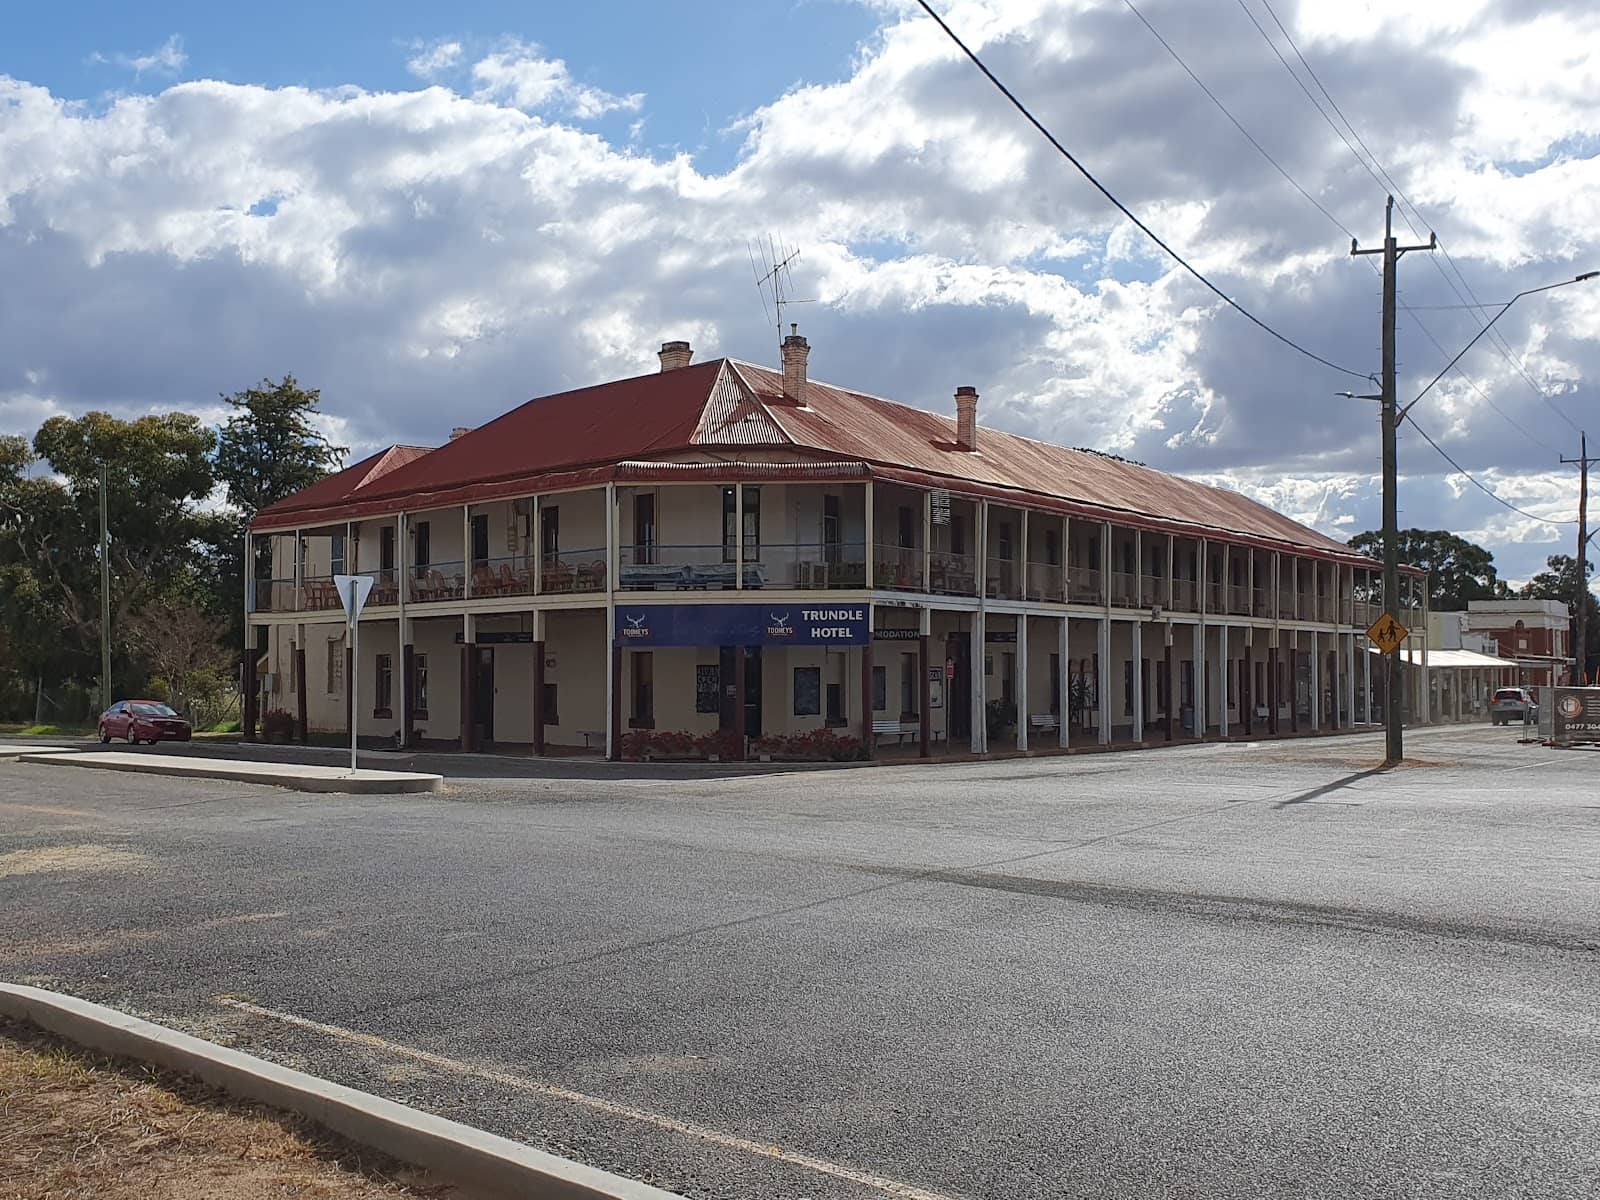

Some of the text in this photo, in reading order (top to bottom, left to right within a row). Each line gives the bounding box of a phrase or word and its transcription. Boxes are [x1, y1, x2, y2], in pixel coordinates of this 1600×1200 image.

[801, 610, 864, 621] TRUNDLE
[767, 626, 793, 634] TOOHEYS
[811, 627, 853, 638] HOTEL
